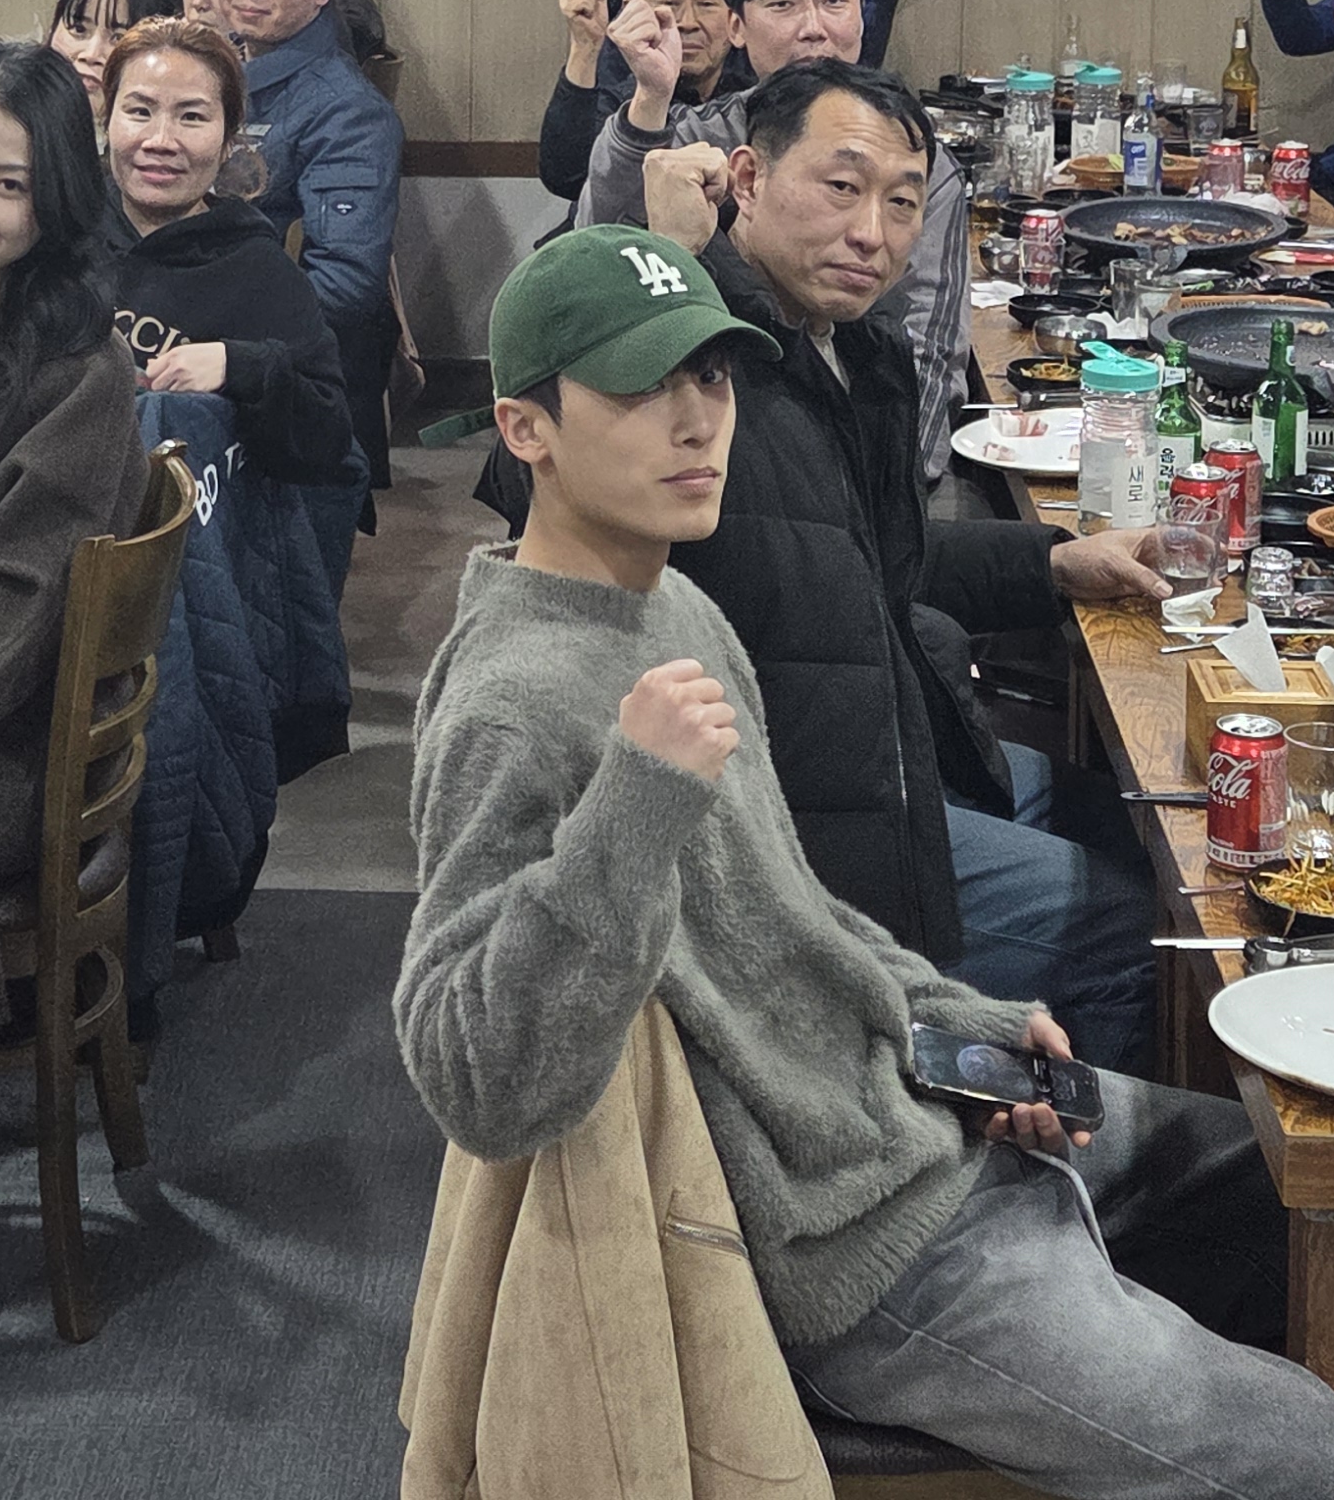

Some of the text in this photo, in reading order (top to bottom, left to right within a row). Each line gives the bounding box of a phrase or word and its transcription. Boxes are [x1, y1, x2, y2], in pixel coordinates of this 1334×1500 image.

[620, 247, 688, 297] LA
[1160, 448, 1176, 463] 음
[1128, 465, 1144, 502] 새로
